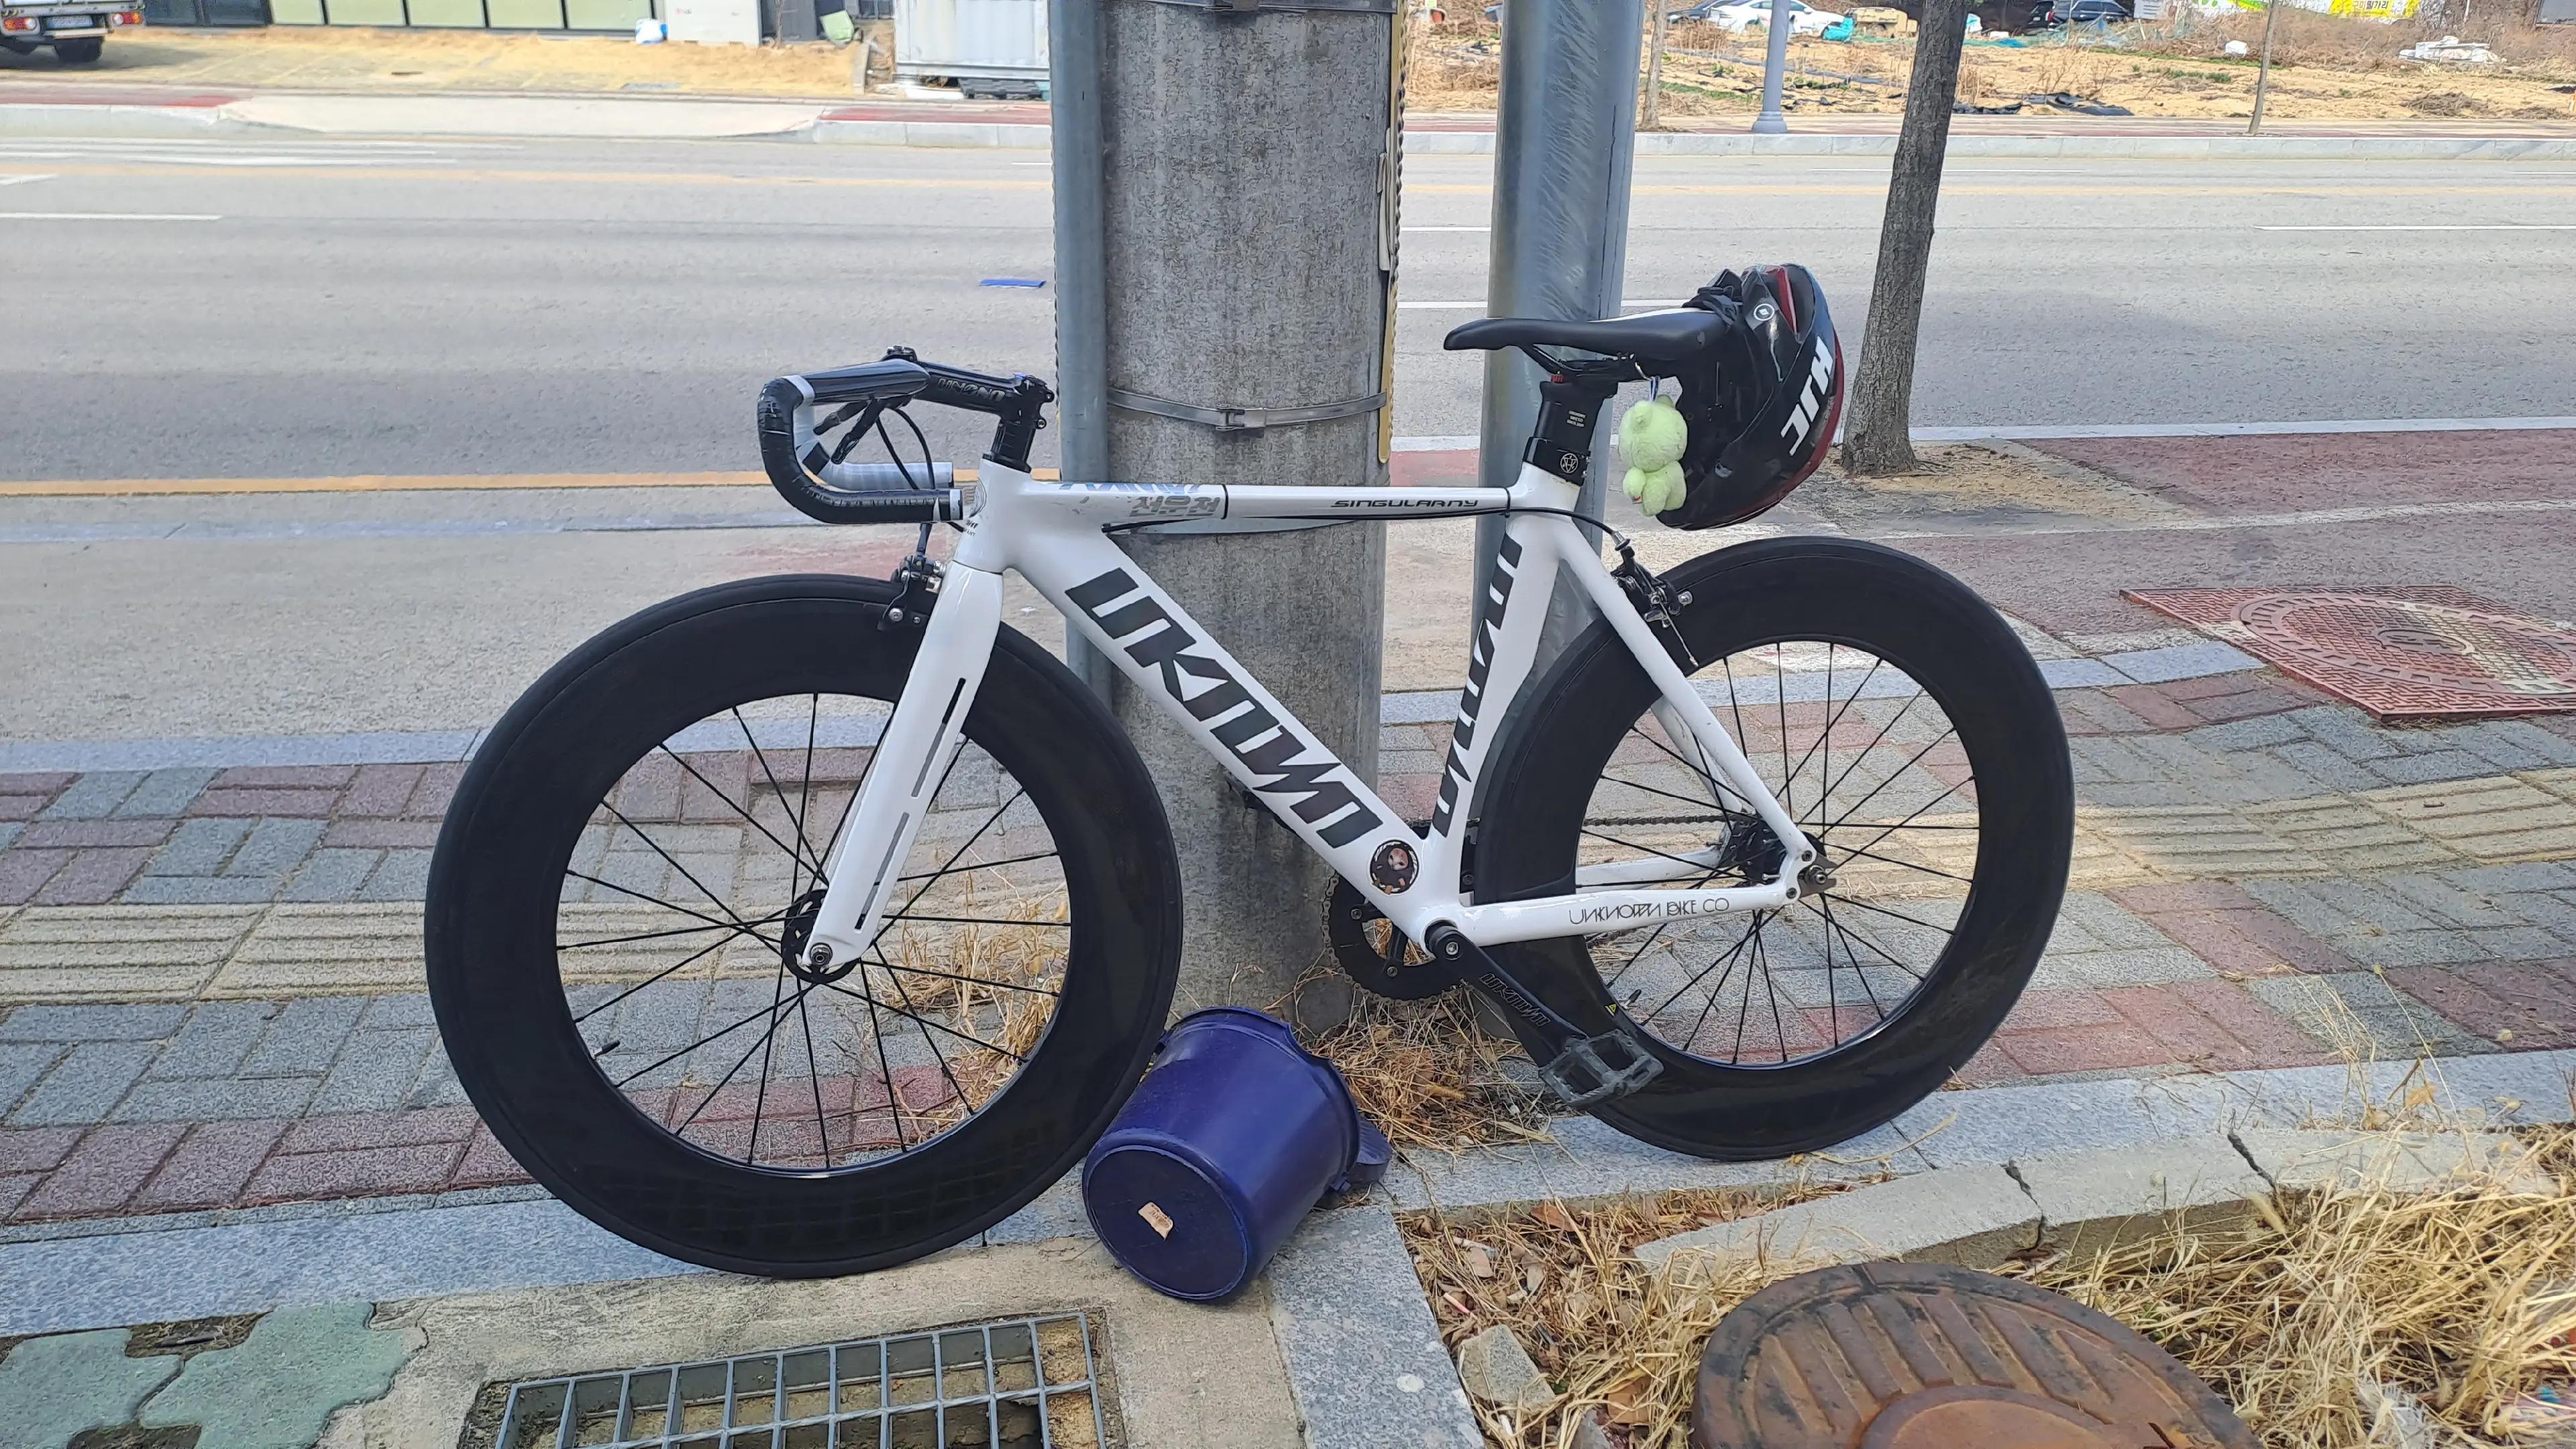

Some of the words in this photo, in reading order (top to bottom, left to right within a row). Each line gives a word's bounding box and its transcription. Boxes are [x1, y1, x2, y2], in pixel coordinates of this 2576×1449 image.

[1780, 335, 1833, 456] HJC
[1666, 900, 1698, 917] BIKE
[1703, 897, 1730, 913] CO
